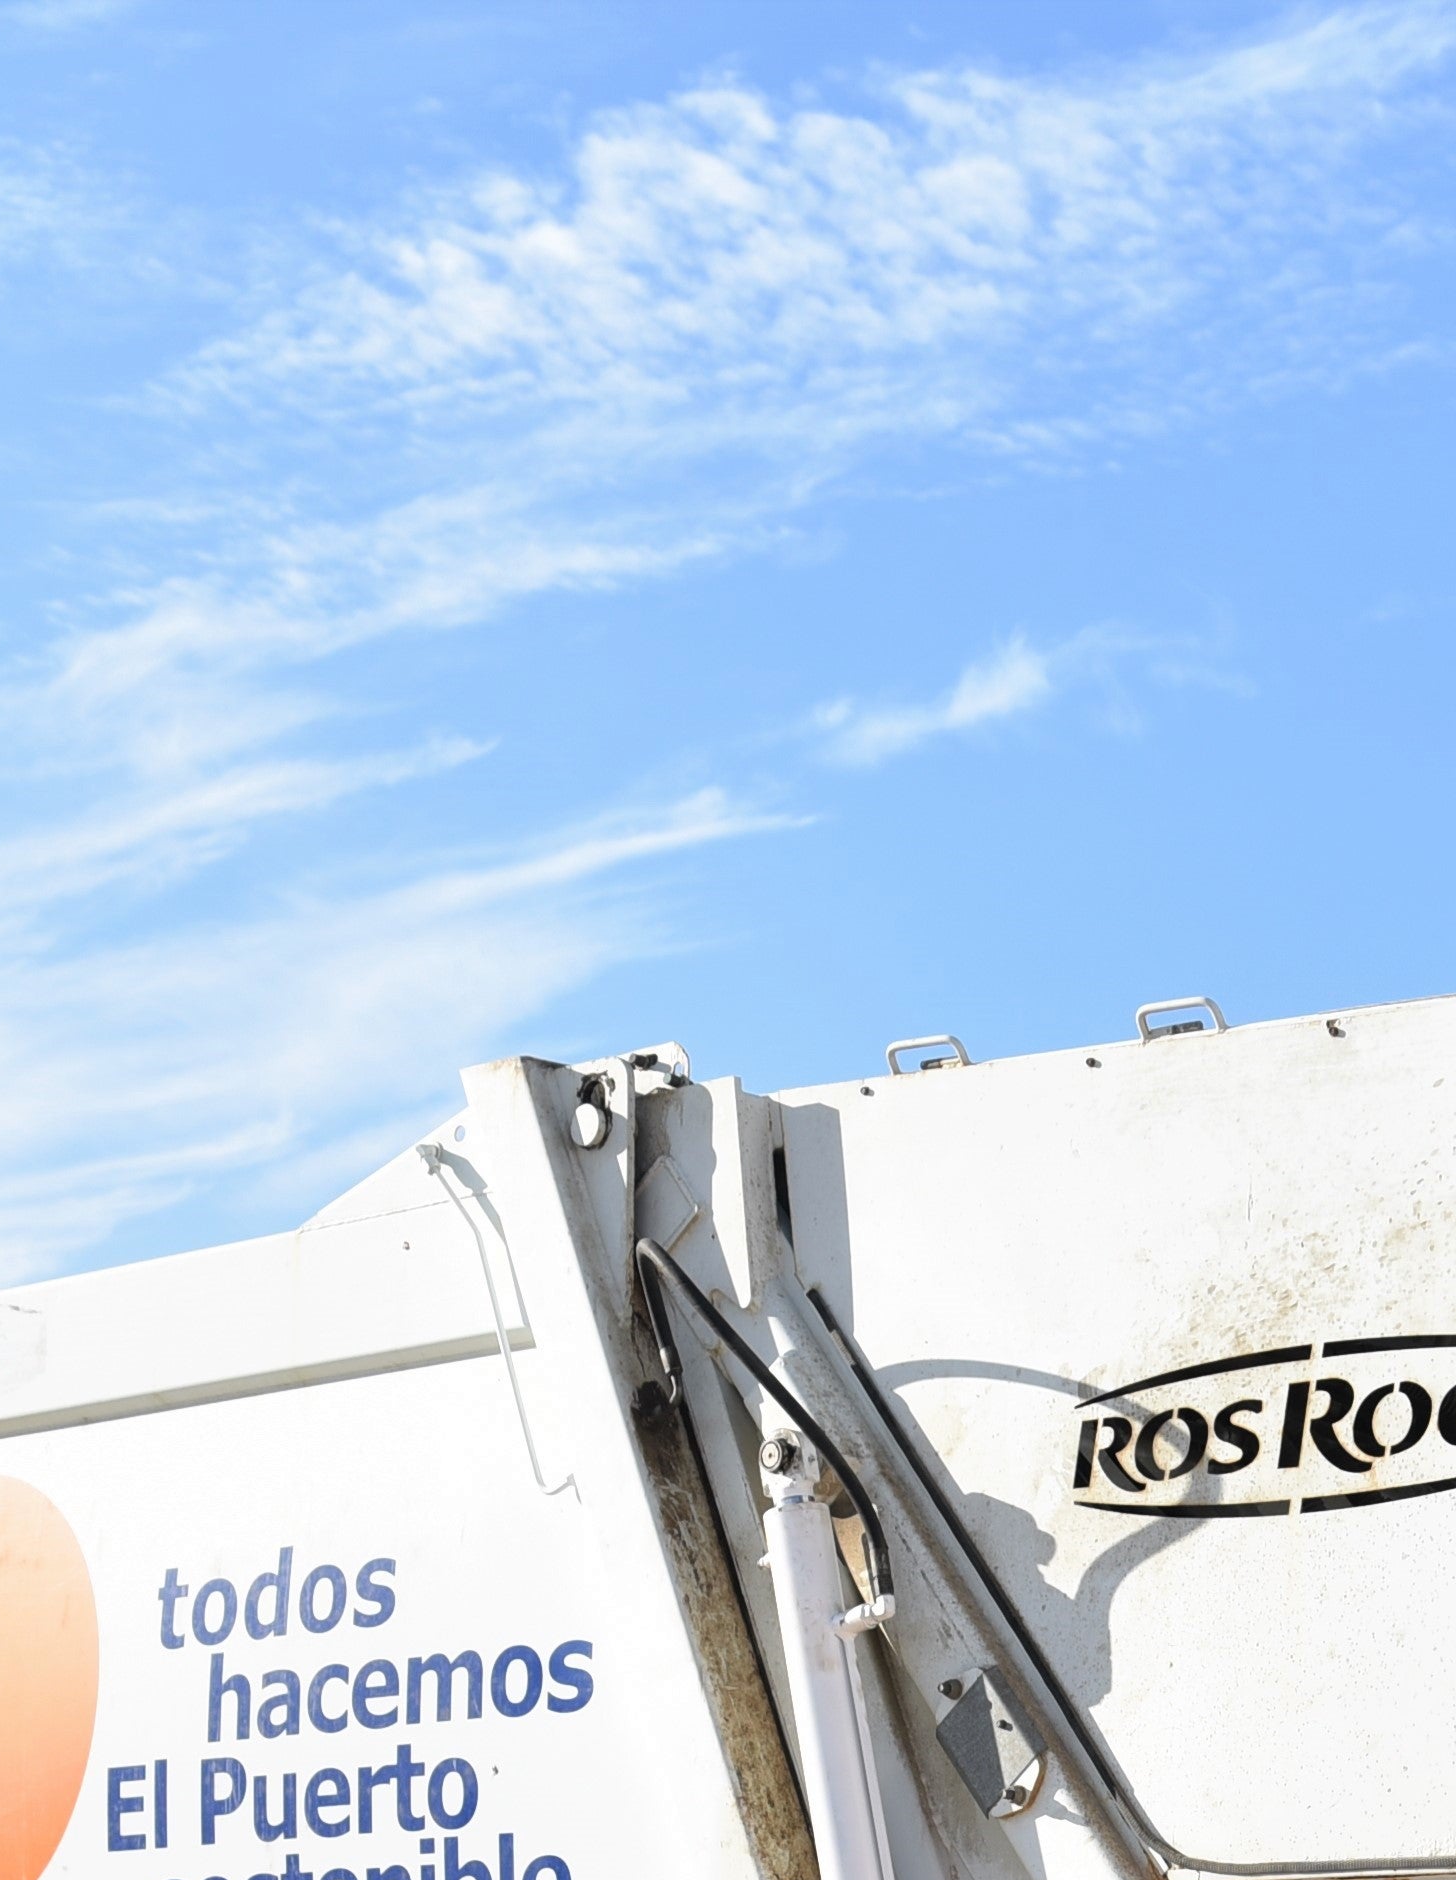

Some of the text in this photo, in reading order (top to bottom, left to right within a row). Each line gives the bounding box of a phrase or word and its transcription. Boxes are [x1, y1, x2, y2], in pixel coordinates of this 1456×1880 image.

[1073, 1399, 1264, 1493] ROS
[157, 1546, 397, 1651] todos
[207, 1640, 594, 1743] hacemos
[106, 1744, 480, 1853] El Puerto
